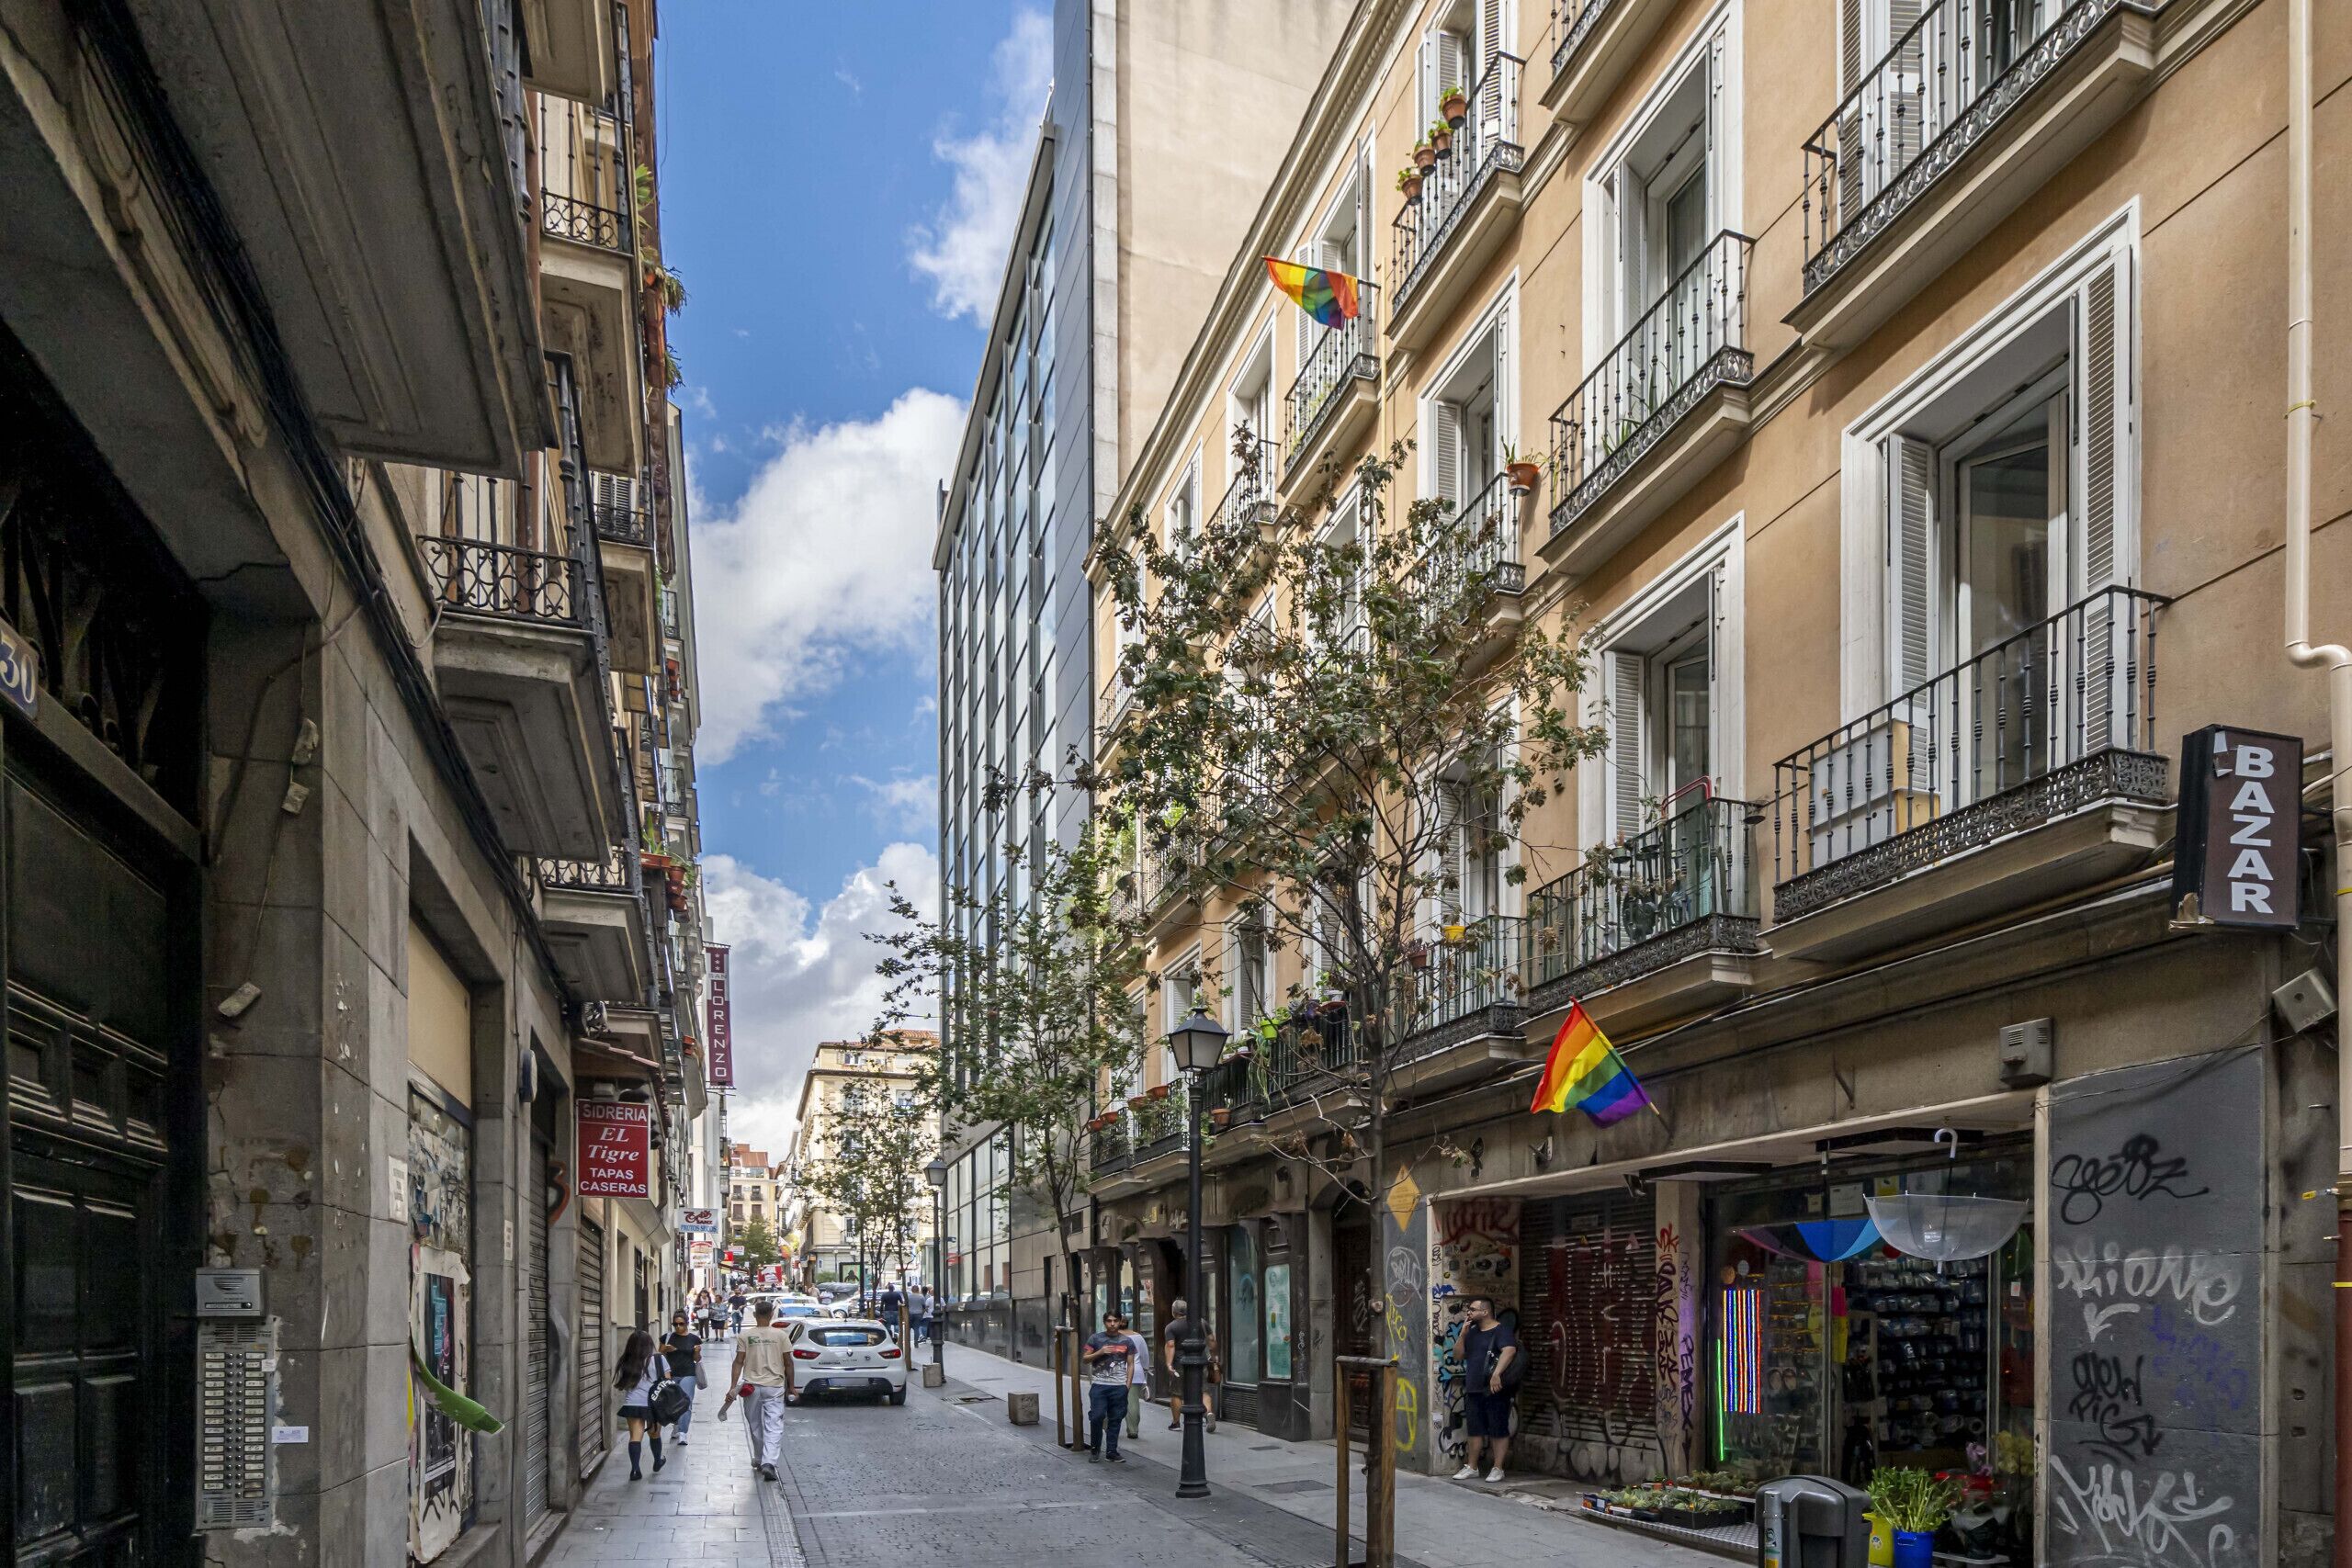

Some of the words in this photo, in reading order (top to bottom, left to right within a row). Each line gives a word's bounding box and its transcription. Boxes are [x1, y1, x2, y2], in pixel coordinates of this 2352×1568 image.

[2227, 744, 2275, 914] BAZAR
[712, 981, 727, 1077] LORENZO
[582, 1104, 647, 1122] SIDRERIA
[600, 1127, 629, 1142] EL
[588, 1145, 639, 1163] Tigre
[589, 1168, 634, 1179] TAPAS
[580, 1180, 647, 1194] CASERAS
